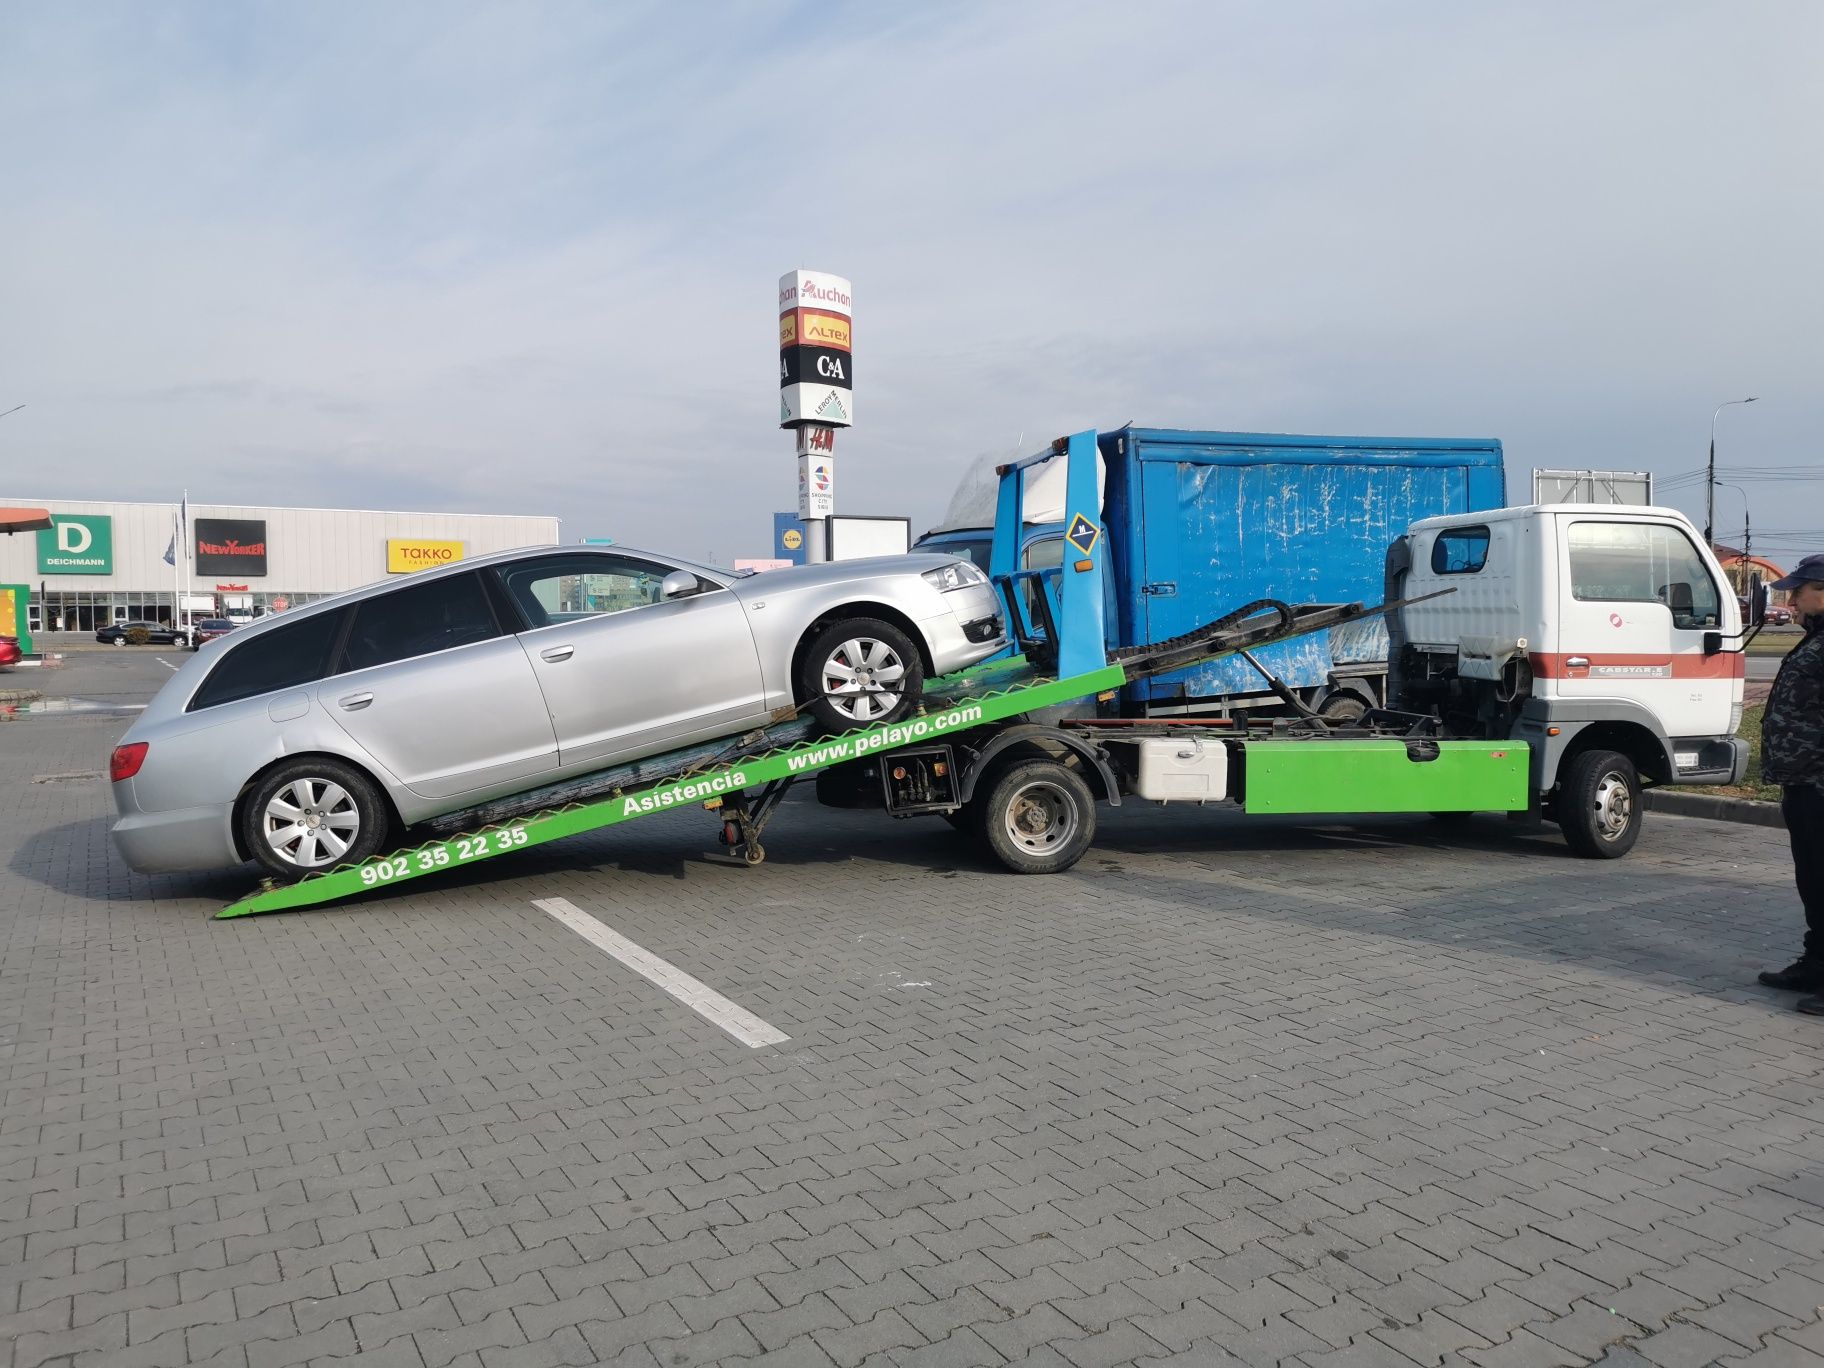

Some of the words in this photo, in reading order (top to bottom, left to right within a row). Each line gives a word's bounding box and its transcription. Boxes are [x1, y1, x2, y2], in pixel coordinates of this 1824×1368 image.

[801, 280, 851, 308] Auchan
[816, 355, 845, 380] C&A
[810, 427, 834, 452] H&M
[57, 522, 92, 554] D
[46, 558, 105, 566] DEICHMANN
[787, 704, 982, 772] www.pelayo.com
[623, 769, 747, 816] Asistencia
[360, 857, 411, 886] 902
[418, 847, 451, 871] 35
[456, 836, 490, 861] 22
[495, 826, 529, 850] 35
